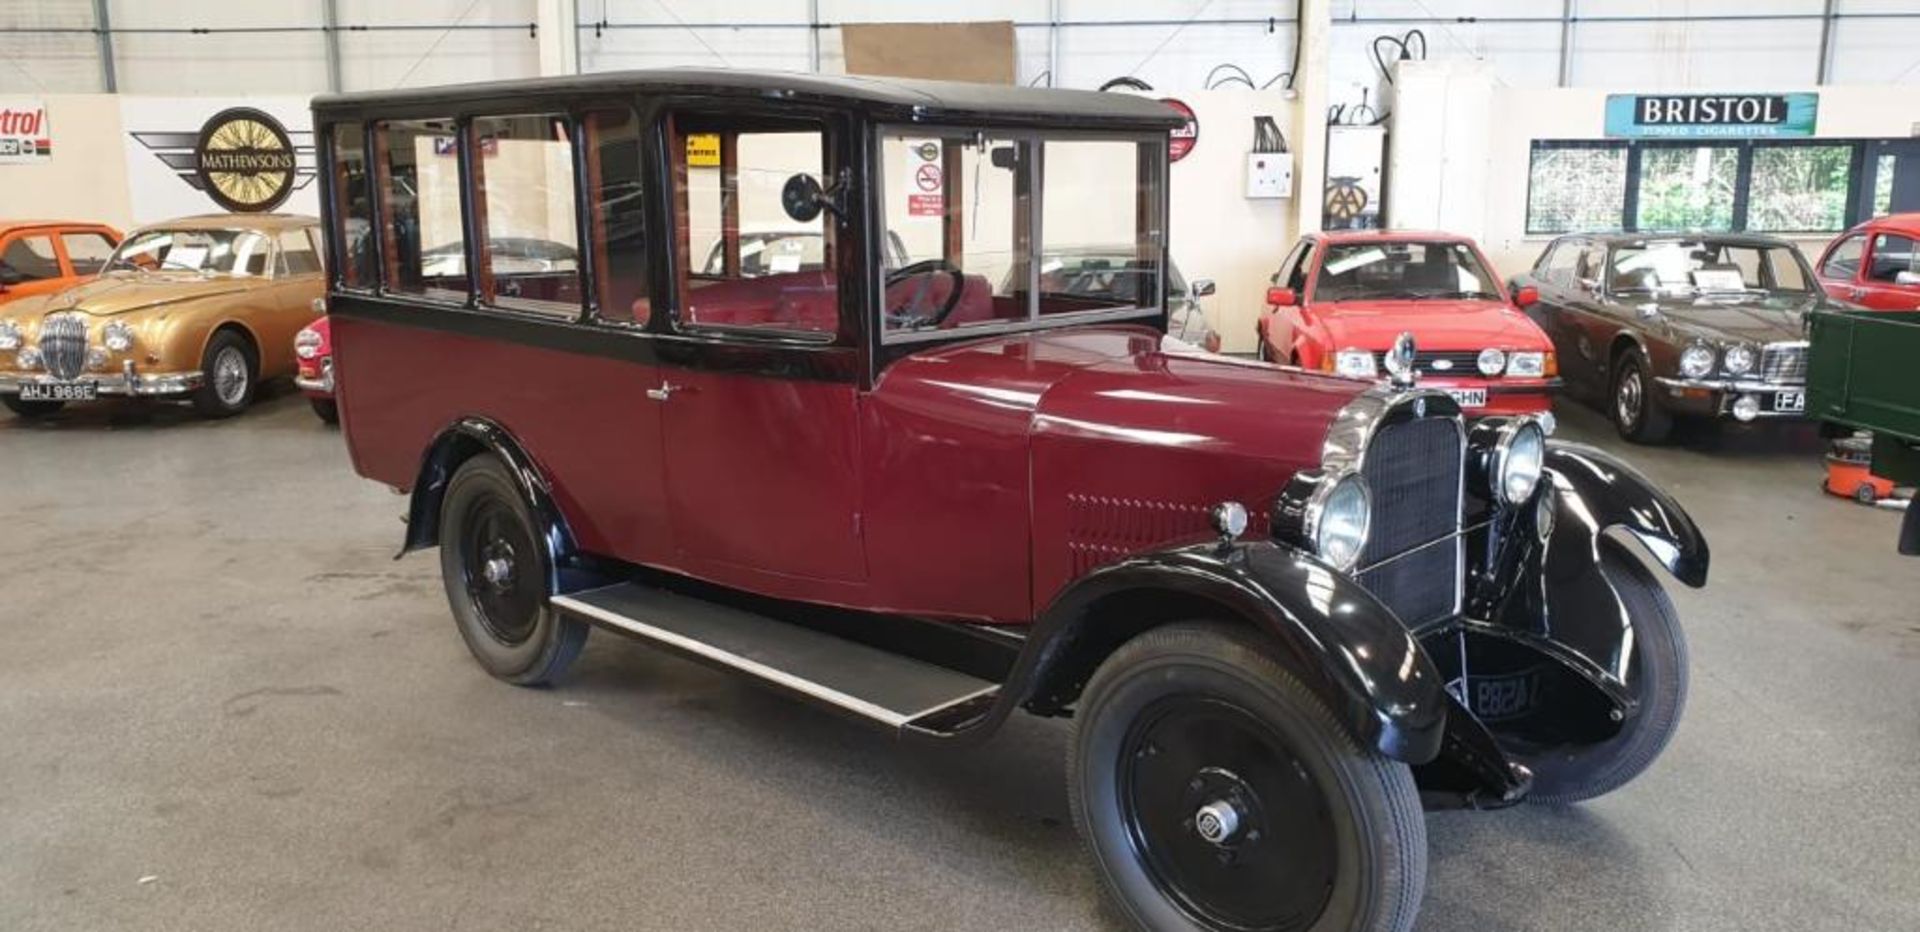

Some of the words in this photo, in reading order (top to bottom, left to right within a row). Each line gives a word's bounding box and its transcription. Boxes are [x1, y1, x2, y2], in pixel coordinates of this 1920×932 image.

[1643, 98, 1778, 123] BRISTOL
[201, 153, 292, 169] MATHEWSONS
[20, 385, 50, 399] AHJ
